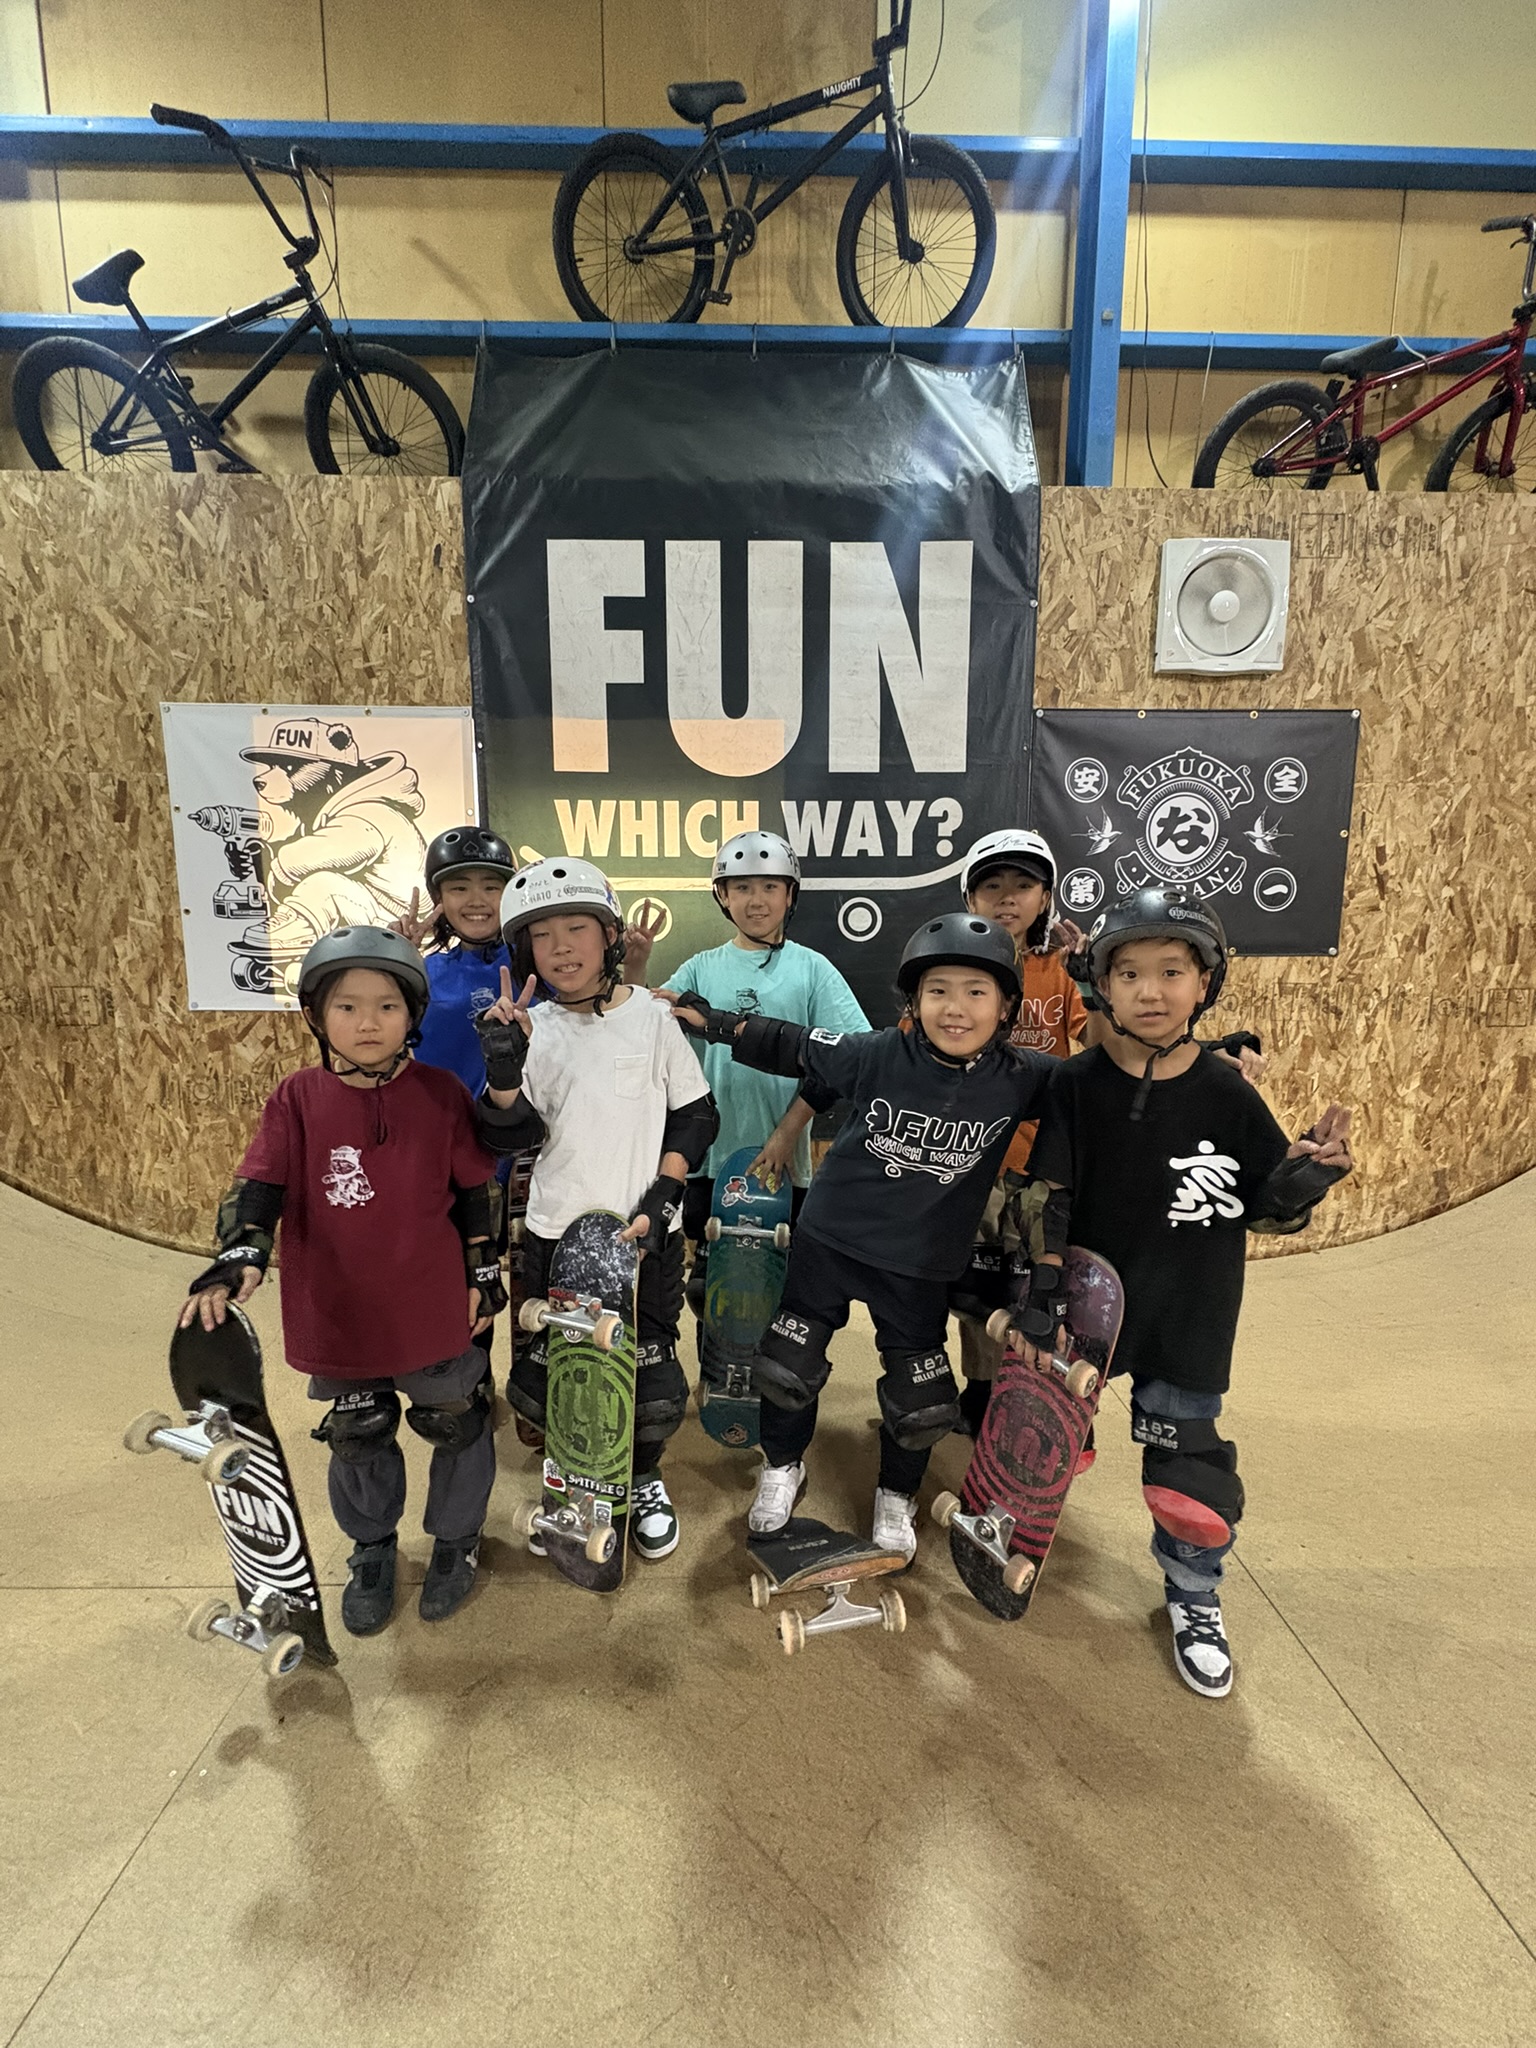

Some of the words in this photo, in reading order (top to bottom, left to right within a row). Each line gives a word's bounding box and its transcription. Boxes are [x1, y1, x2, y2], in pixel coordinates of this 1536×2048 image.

[823, 76, 861, 98] NAUGHTY
[547, 539, 974, 777] FUN
[276, 729, 312, 749] FUN
[1073, 767, 1100, 795] 安
[1125, 757, 1244, 804] FUKUOKA
[1273, 766, 1300, 793] 全
[554, 799, 759, 858] WHICH
[781, 797, 963, 857] WAY?
[1156, 805, 1212, 855] な
[1070, 876, 1096, 903] 第
[891, 1110, 984, 1151] FUN
[873, 1134, 922, 1161] WHICH
[779, 1314, 809, 1335] 187
[912, 1370, 936, 1384] KILLER
[913, 1354, 943, 1374] 187
[340, 1391, 373, 1404] 187
[1139, 1418, 1177, 1439] 187
[214, 1485, 285, 1536] FUN
[254, 1530, 286, 1548] WAY?
